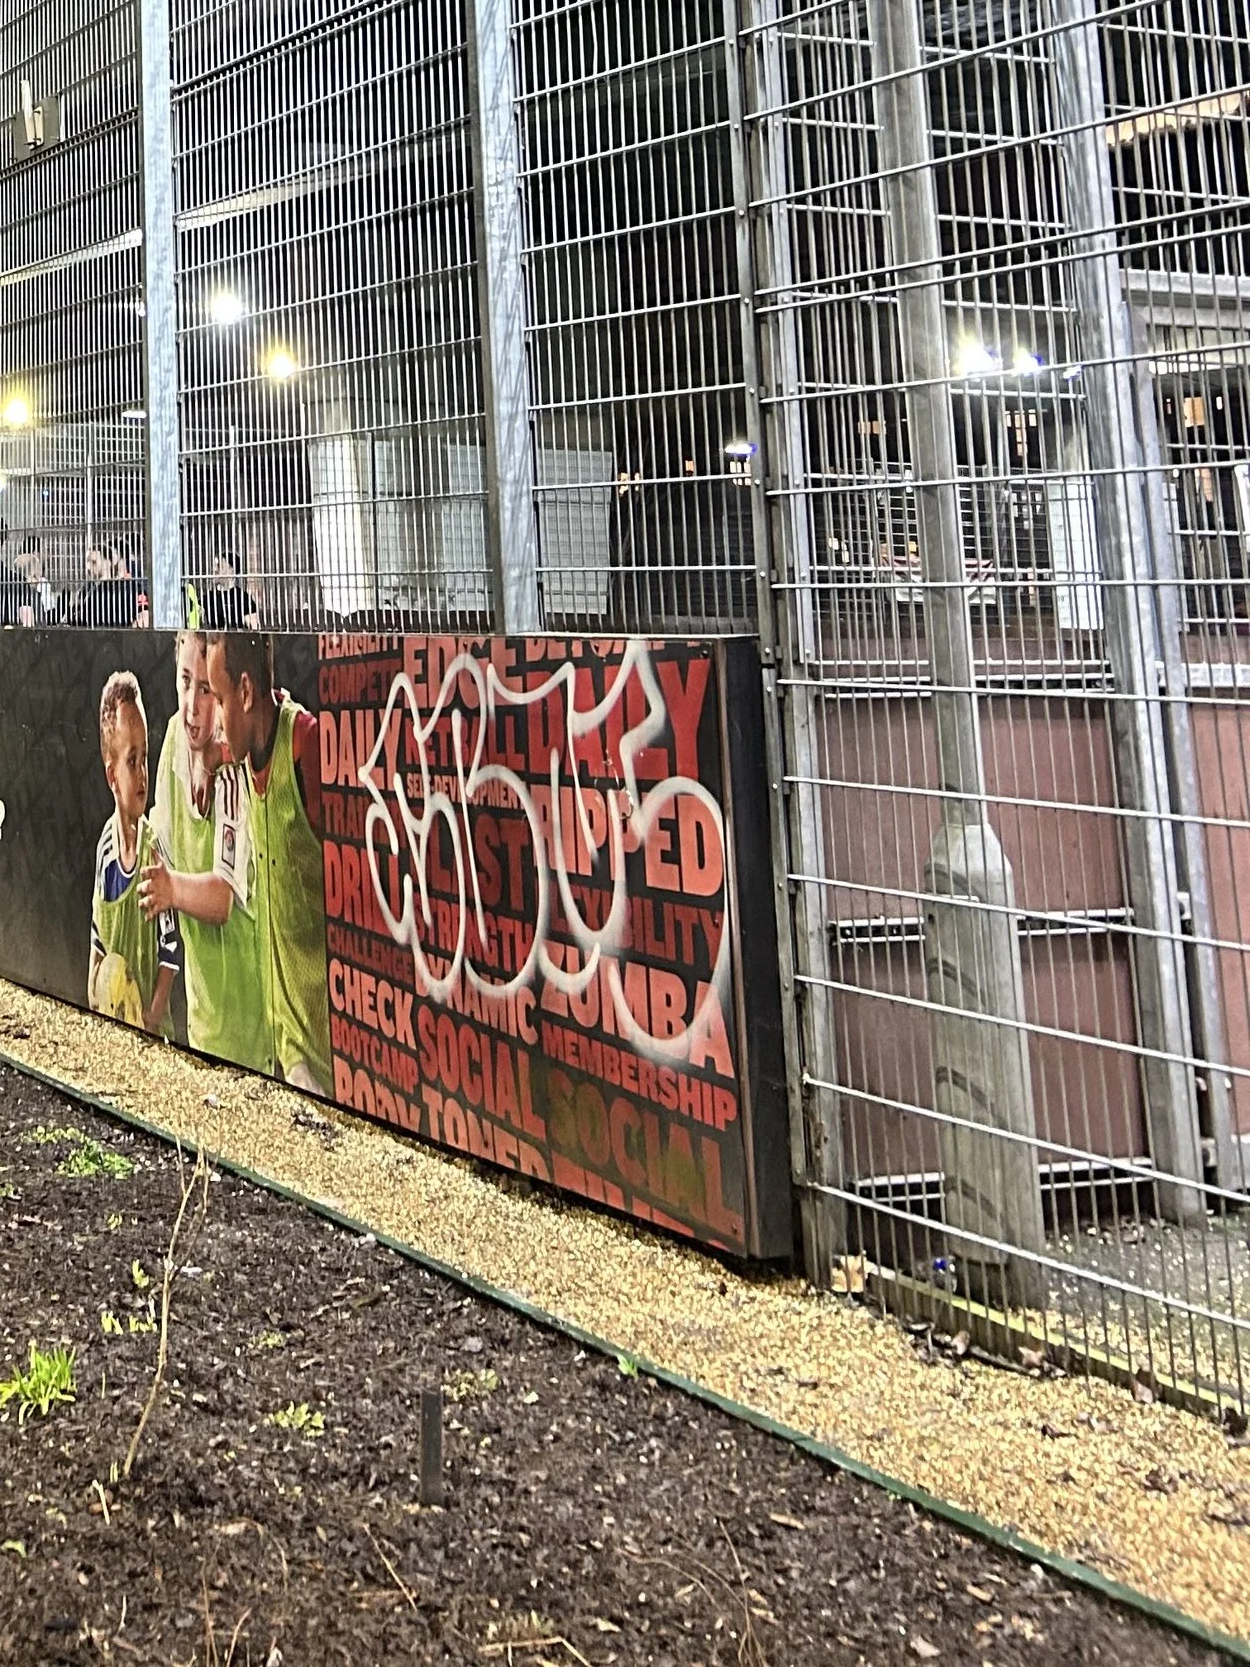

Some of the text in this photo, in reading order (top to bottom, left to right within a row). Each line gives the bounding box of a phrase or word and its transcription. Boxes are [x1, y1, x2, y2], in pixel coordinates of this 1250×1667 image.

[403, 636, 524, 710] EDGE
[526, 657, 711, 780] DAILY
[319, 708, 402, 791] DAILY
[323, 840, 401, 935] DRILL
[530, 784, 724, 896] RIPPED
[534, 878, 725, 974] LXIBILITY
[329, 958, 418, 1051] CHECK
[331, 1013, 419, 1095] BOOTCAMP
[540, 938, 735, 1079] ZUMBA
[417, 1005, 546, 1143] SOCIAL
[541, 1019, 738, 1132] MEMBERSHIP
[549, 1069, 745, 1246] SOCIAL
